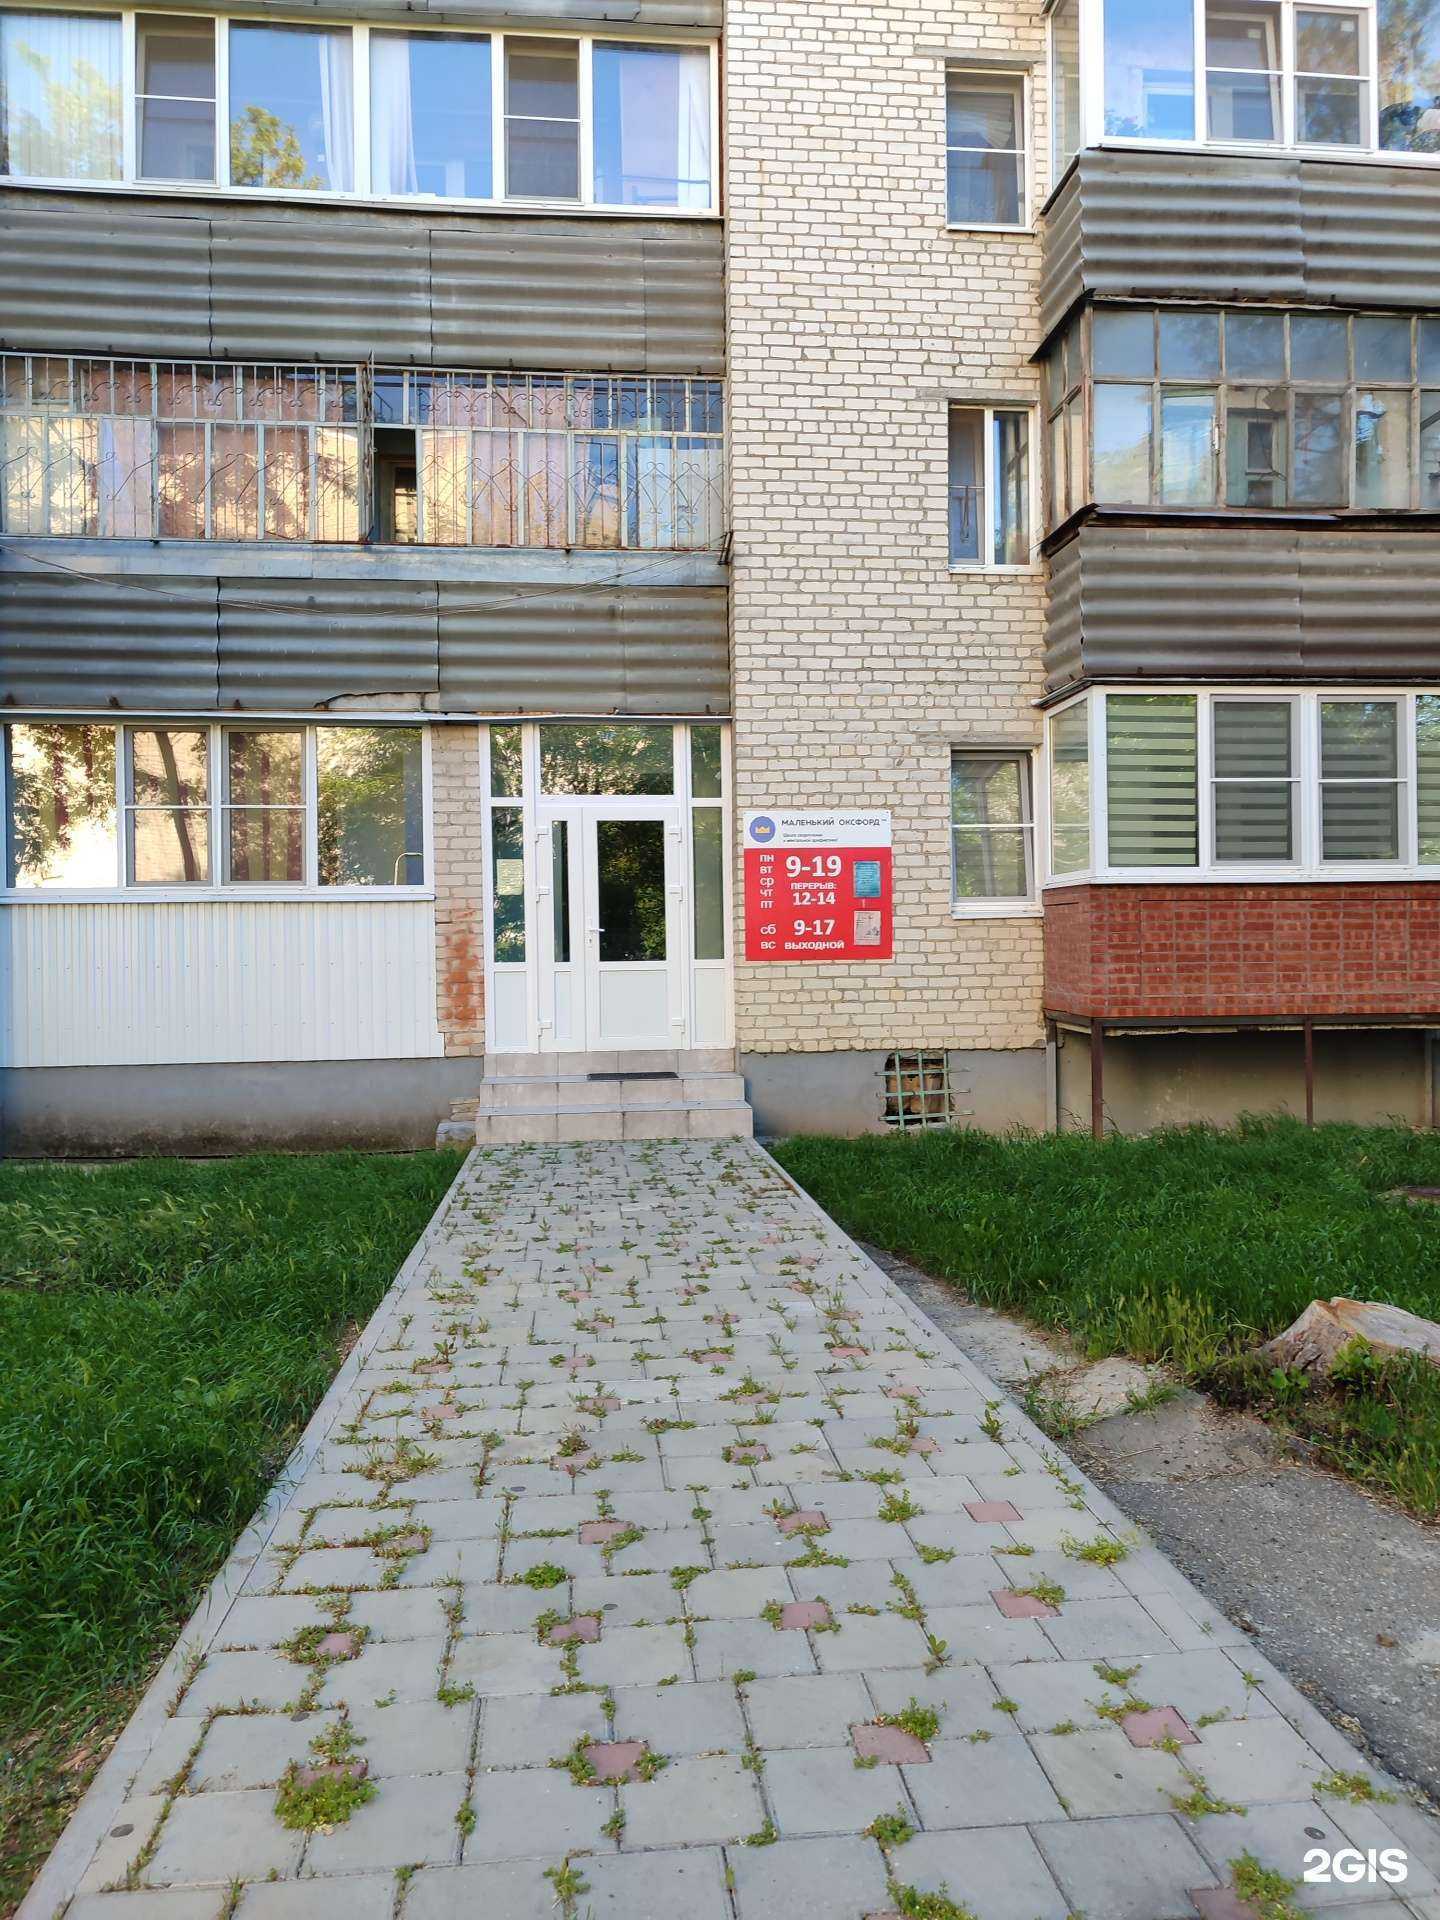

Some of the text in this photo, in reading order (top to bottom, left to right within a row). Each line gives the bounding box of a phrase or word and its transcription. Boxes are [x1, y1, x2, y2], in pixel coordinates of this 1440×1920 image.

[781, 817, 880, 826] МАЛЕНЬКИЙ ОКСФОРД
[786, 855, 842, 877] 9-19
[793, 892, 836, 906] 12-14
[793, 920, 835, 936] 9-17
[784, 940, 844, 950] ВЫХОДНОЙ
